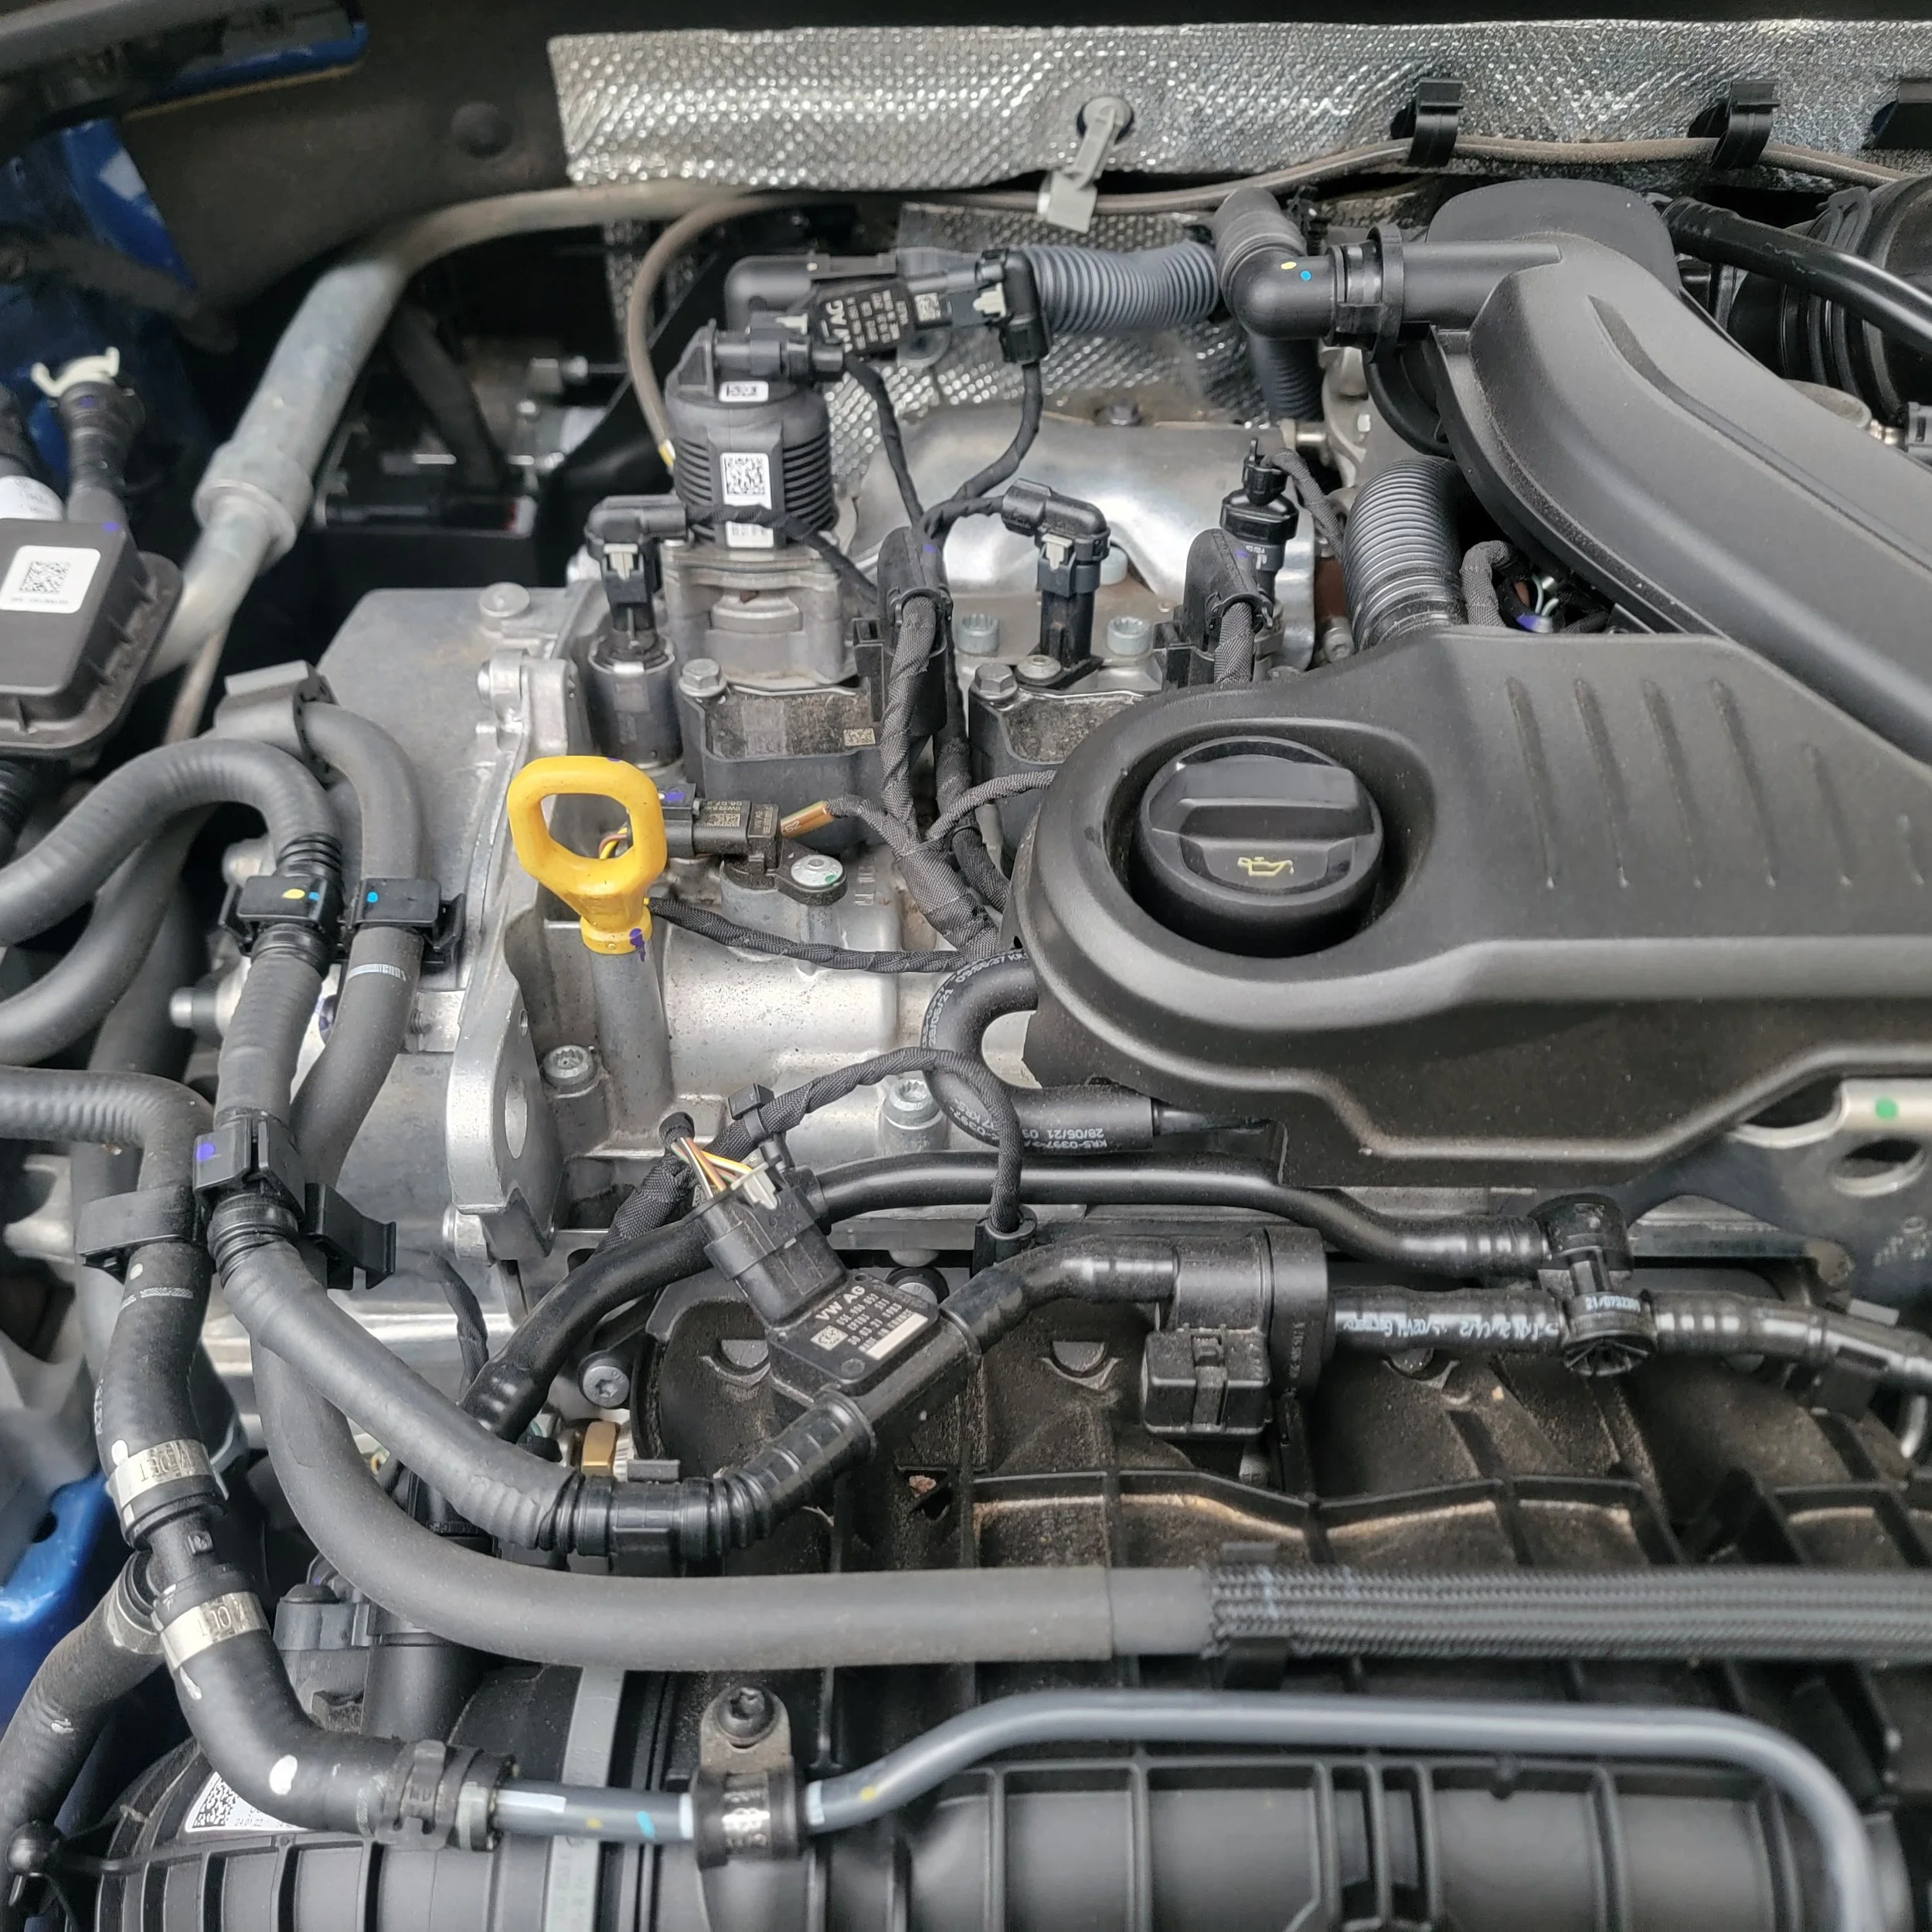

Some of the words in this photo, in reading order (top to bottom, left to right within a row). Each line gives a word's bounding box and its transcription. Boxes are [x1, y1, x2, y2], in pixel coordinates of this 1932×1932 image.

[825, 300, 847, 325] AG
[1047, 1128, 1104, 1139] 28/06/21
[815, 1301, 843, 1321] VW
[843, 1285, 866, 1304] AG
